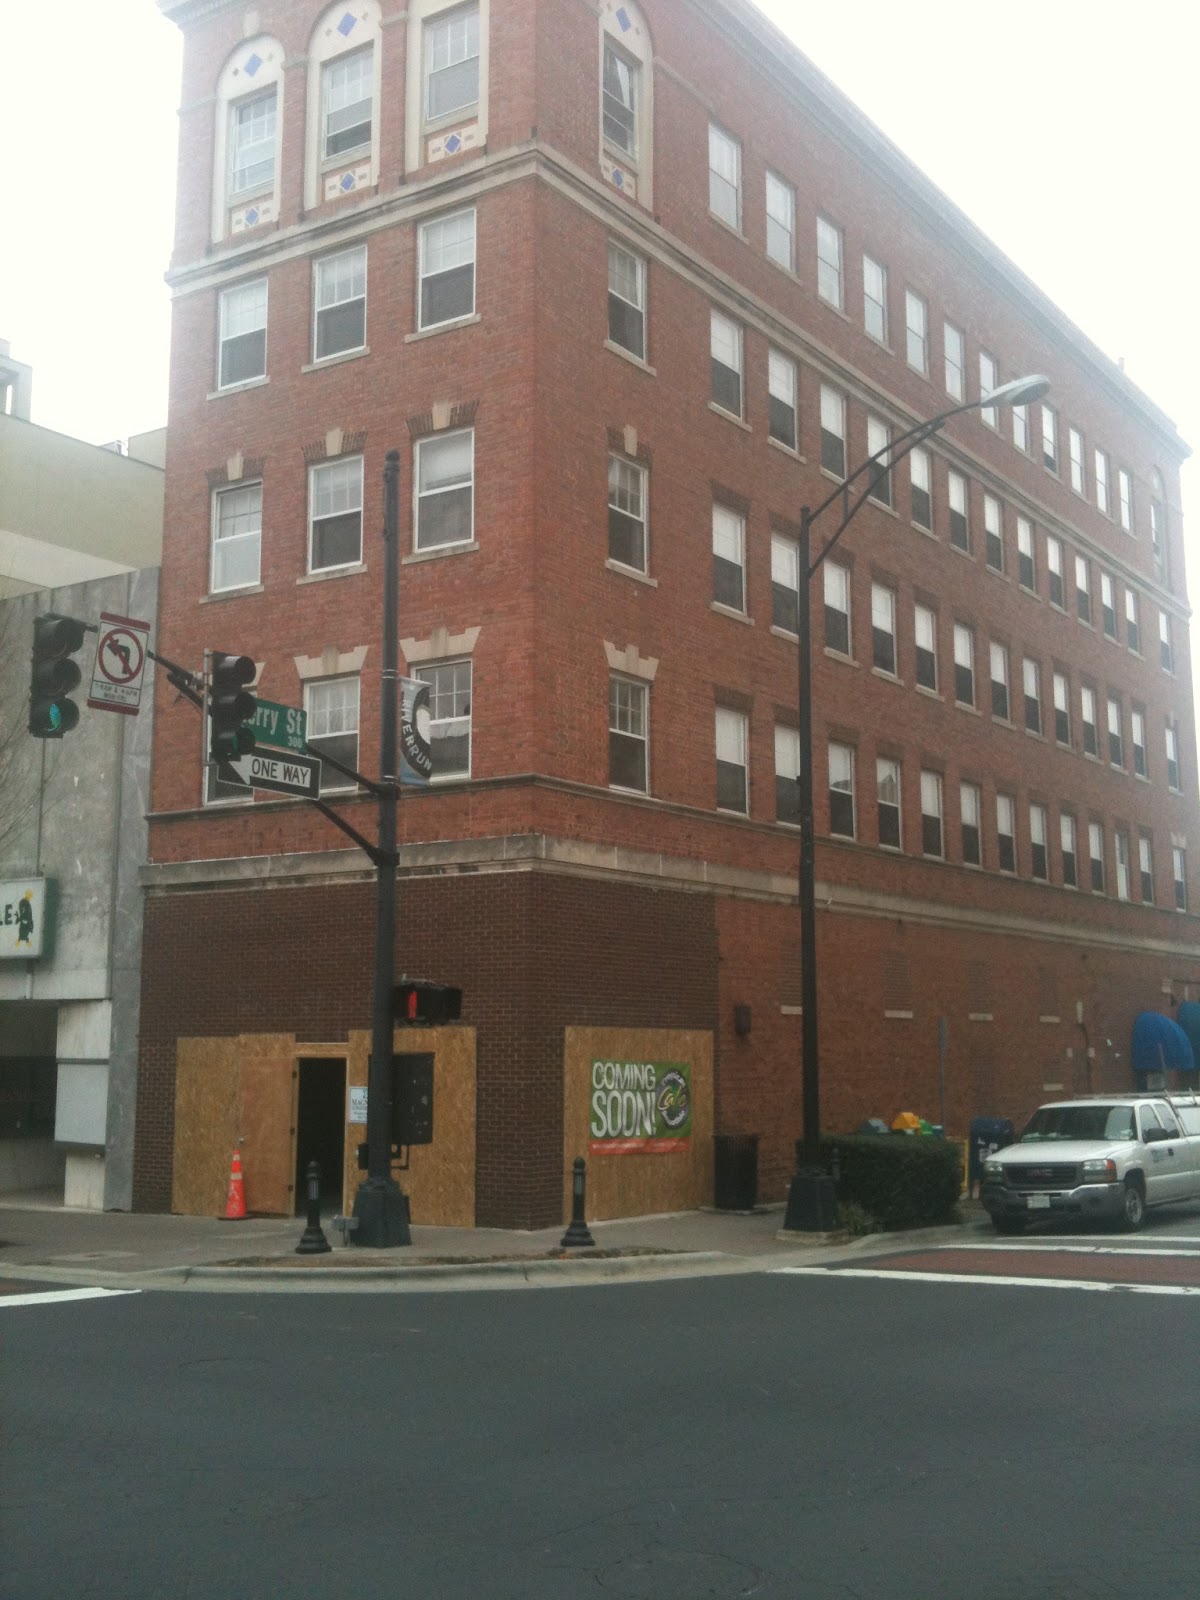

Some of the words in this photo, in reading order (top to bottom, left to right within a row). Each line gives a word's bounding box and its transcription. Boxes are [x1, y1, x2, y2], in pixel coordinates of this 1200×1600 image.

[286, 708, 302, 736] St
[401, 699, 432, 770] RIVERRUN
[287, 736, 302, 748] 300
[251, 758, 279, 779] ONE
[283, 764, 309, 785] WAY
[592, 1061, 656, 1090] COMING
[591, 1090, 657, 1137] SOON!
